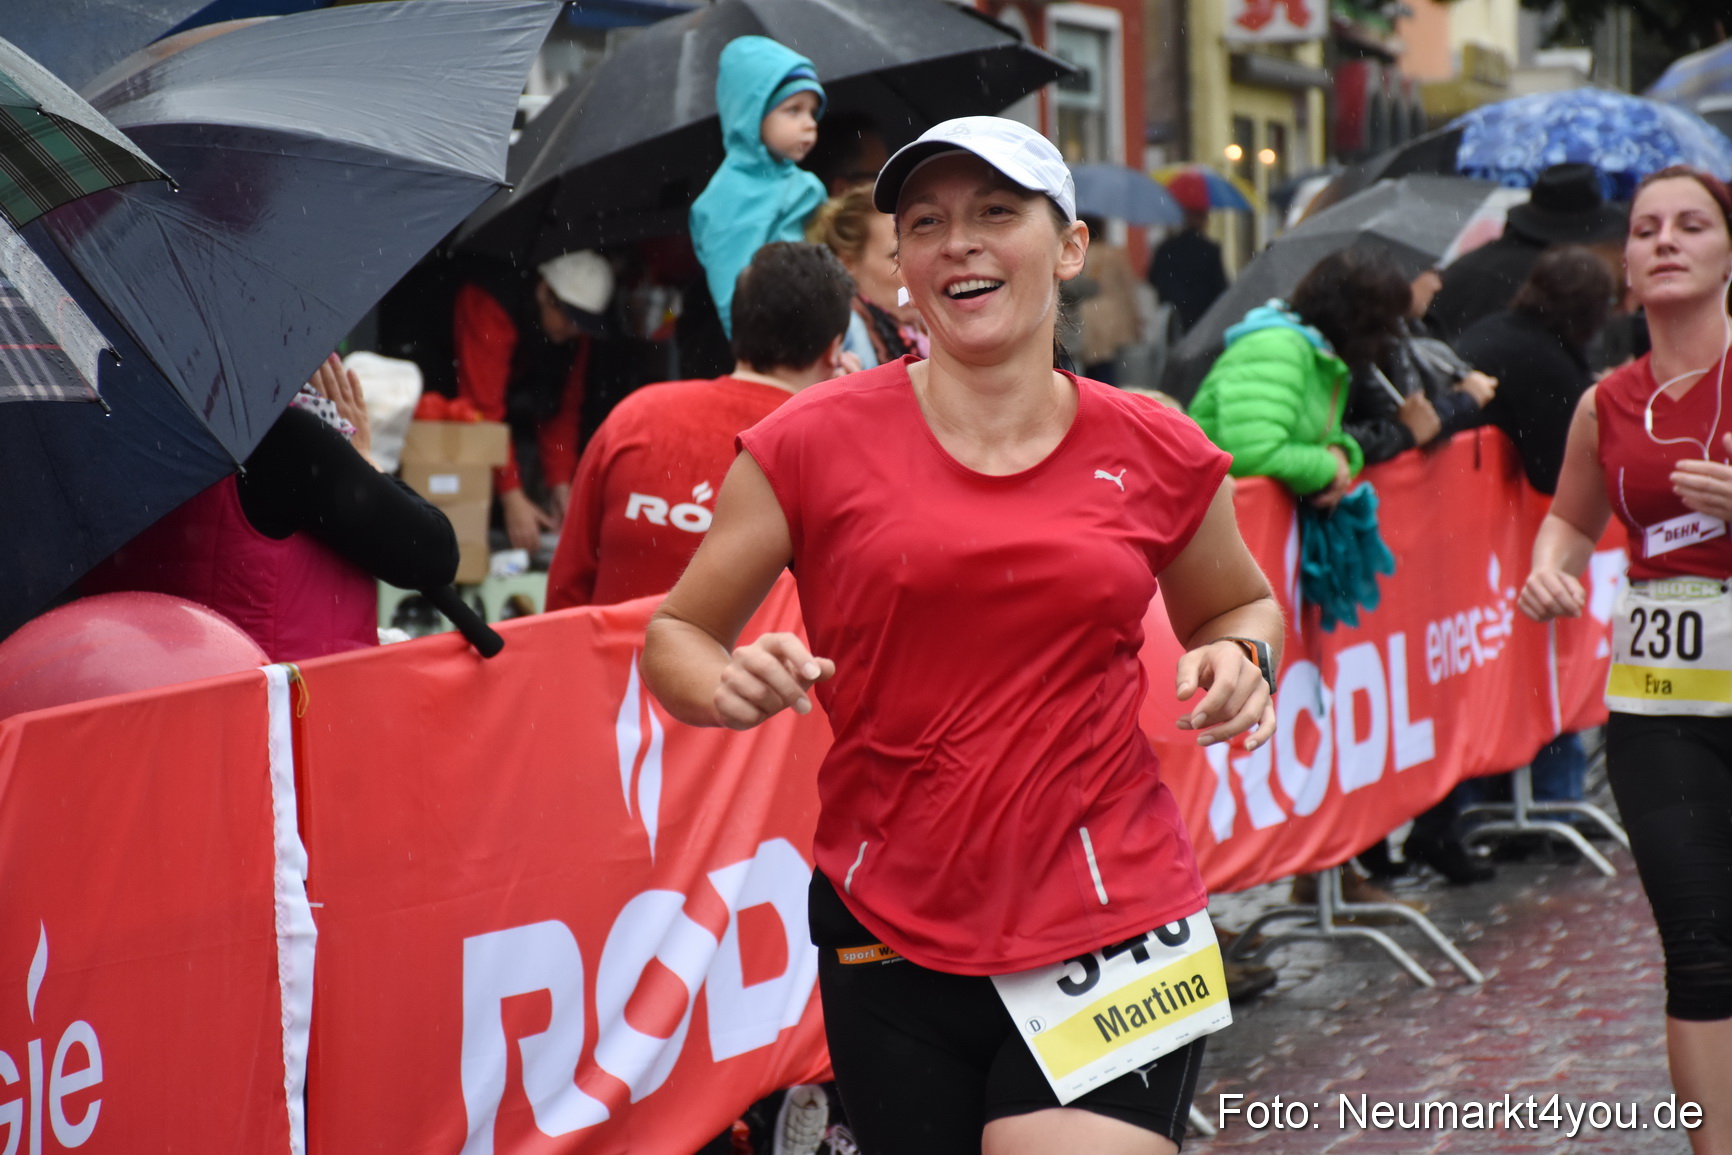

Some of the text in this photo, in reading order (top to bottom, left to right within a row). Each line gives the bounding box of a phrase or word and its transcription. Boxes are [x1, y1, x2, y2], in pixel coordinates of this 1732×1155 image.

[1664, 521, 1700, 543] DEHN
[1630, 607, 1703, 661] 230
[1645, 673, 1672, 695] Eva
[843, 949, 875, 962] sport
[1092, 973, 1211, 1044] Martina
